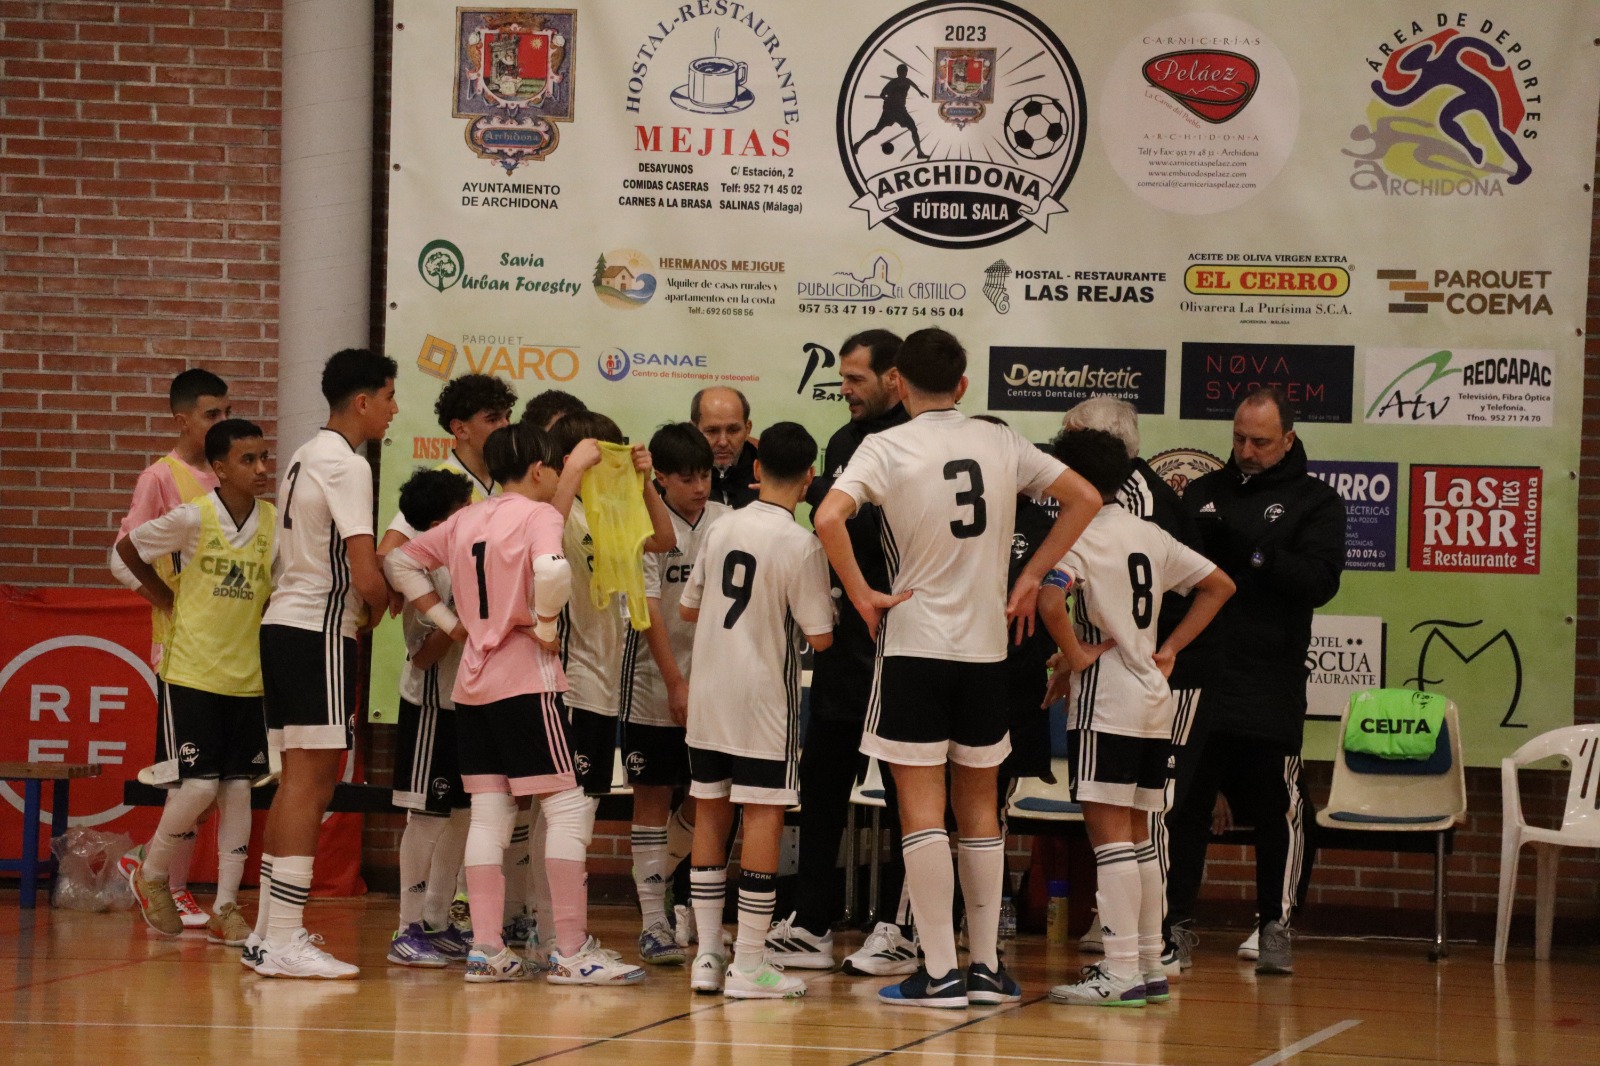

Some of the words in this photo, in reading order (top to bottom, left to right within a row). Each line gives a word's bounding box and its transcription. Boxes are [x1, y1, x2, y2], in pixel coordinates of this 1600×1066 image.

[945, 25, 987, 42] 2023
[626, 0, 800, 125] HOSTAL-RESTAURANTE
[1155, 59, 1239, 82] Peláez
[1366, 21, 1423, 73] ÁREA
[1437, 12, 1467, 27] DE
[1479, 19, 1541, 140] DEPORTES
[485, 130, 539, 142] Archidona
[634, 125, 790, 157] MEJIAS
[638, 163, 693, 174] DESAYUNOS
[731, 166, 741, 176] C/
[742, 166, 786, 179] Estación,
[788, 168, 794, 177] 2
[462, 182, 561, 195] AYUNTAMIENTO
[623, 179, 663, 190] COMIDAS
[666, 181, 709, 191] CASERAS
[721, 183, 741, 193] Telf:
[743, 184, 760, 194] 952
[763, 184, 774, 194] 71
[777, 185, 788, 194] 45
[791, 185, 803, 195] 02
[877, 165, 1040, 201] ARCHIDONA
[462, 196, 478, 207] DE
[482, 197, 558, 209] ARCHIDONA
[618, 196, 656, 207] CARNES
[658, 198, 665, 207] A
[666, 198, 678, 208] LA
[681, 199, 712, 209] BRASA
[719, 200, 760, 210] SALINAS
[762, 201, 803, 214] (Málaga)
[913, 198, 968, 220] FÚTBOL
[972, 203, 1009, 221] SALA
[500, 252, 544, 268] Savia
[659, 257, 728, 270] HERMANOS
[731, 260, 785, 272] MEJIGUE
[1188, 253, 1223, 261] ACEITE
[1243, 254, 1272, 262] OLIVA
[1314, 255, 1347, 263] EXTRA
[1015, 270, 1063, 280] HOSTAL
[1074, 271, 1167, 281] RESTAURANTE
[1196, 271, 1231, 289] EL
[1240, 271, 1338, 291] CERRO
[1434, 269, 1552, 289] PARQUET
[461, 274, 509, 291] Urban
[515, 276, 581, 297] Forestry
[667, 277, 699, 290] Alquiler
[701, 279, 712, 289] de
[714, 282, 738, 290] casas
[740, 281, 771, 291] rurales
[797, 282, 882, 298] PUBLICIDAD
[908, 282, 967, 300] CASTILLO
[665, 293, 725, 304] apartamentos
[727, 295, 739, 303] en
[741, 294, 749, 304] la
[751, 296, 776, 305] costa
[1025, 285, 1068, 301] LAS
[1077, 286, 1154, 303] REJAS
[706, 307, 720, 315] 692
[721, 308, 731, 316] 60
[732, 308, 743, 316] 58
[744, 309, 754, 317] 56
[799, 304, 821, 314] 957
[824, 305, 839, 314] 53
[843, 305, 857, 314] 47
[862, 305, 876, 315] 19
[886, 306, 908, 316] 677
[912, 306, 927, 316] 54
[930, 307, 945, 317] 85
[949, 307, 964, 317] 04
[1180, 301, 1235, 313] Olivarera
[1240, 302, 1254, 313] La
[1258, 302, 1311, 314] Purísima
[1315, 304, 1352, 315] S.C.A.
[1446, 293, 1553, 315] COEMA
[462, 334, 524, 346] PARQUET
[463, 345, 580, 382] VARO
[632, 353, 707, 368] SANAE
[632, 370, 658, 378] Centro
[671, 371, 713, 380] fisioterapia
[1003, 363, 1142, 389] Dentalstetic
[1463, 357, 1552, 387] REDCAPAC
[1007, 389, 1042, 397] Centros
[1045, 389, 1087, 398] Dentales
[1458, 392, 1501, 401] Televisión,
[1524, 393, 1551, 402] Óptica
[943, 459, 987, 539] 3
[1498, 480, 1521, 509] Tres
[1344, 504, 1390, 516] LÉCTRICAS
[1423, 507, 1518, 547] RRR
[1524, 476, 1538, 566] Archidona
[1346, 549, 1360, 558] 670
[1363, 549, 1377, 558] 074
[1423, 546, 1431, 565] BAR
[1434, 550, 1517, 568] Restaurante
[471, 541, 489, 619] 1
[722, 550, 757, 629] 9
[1128, 553, 1153, 630] 8
[1310, 636, 1342, 648] OTEL
[1306, 651, 1372, 672] SCUA
[1308, 673, 1376, 686] TAURANTE
[1360, 718, 1431, 735] CEUTA
